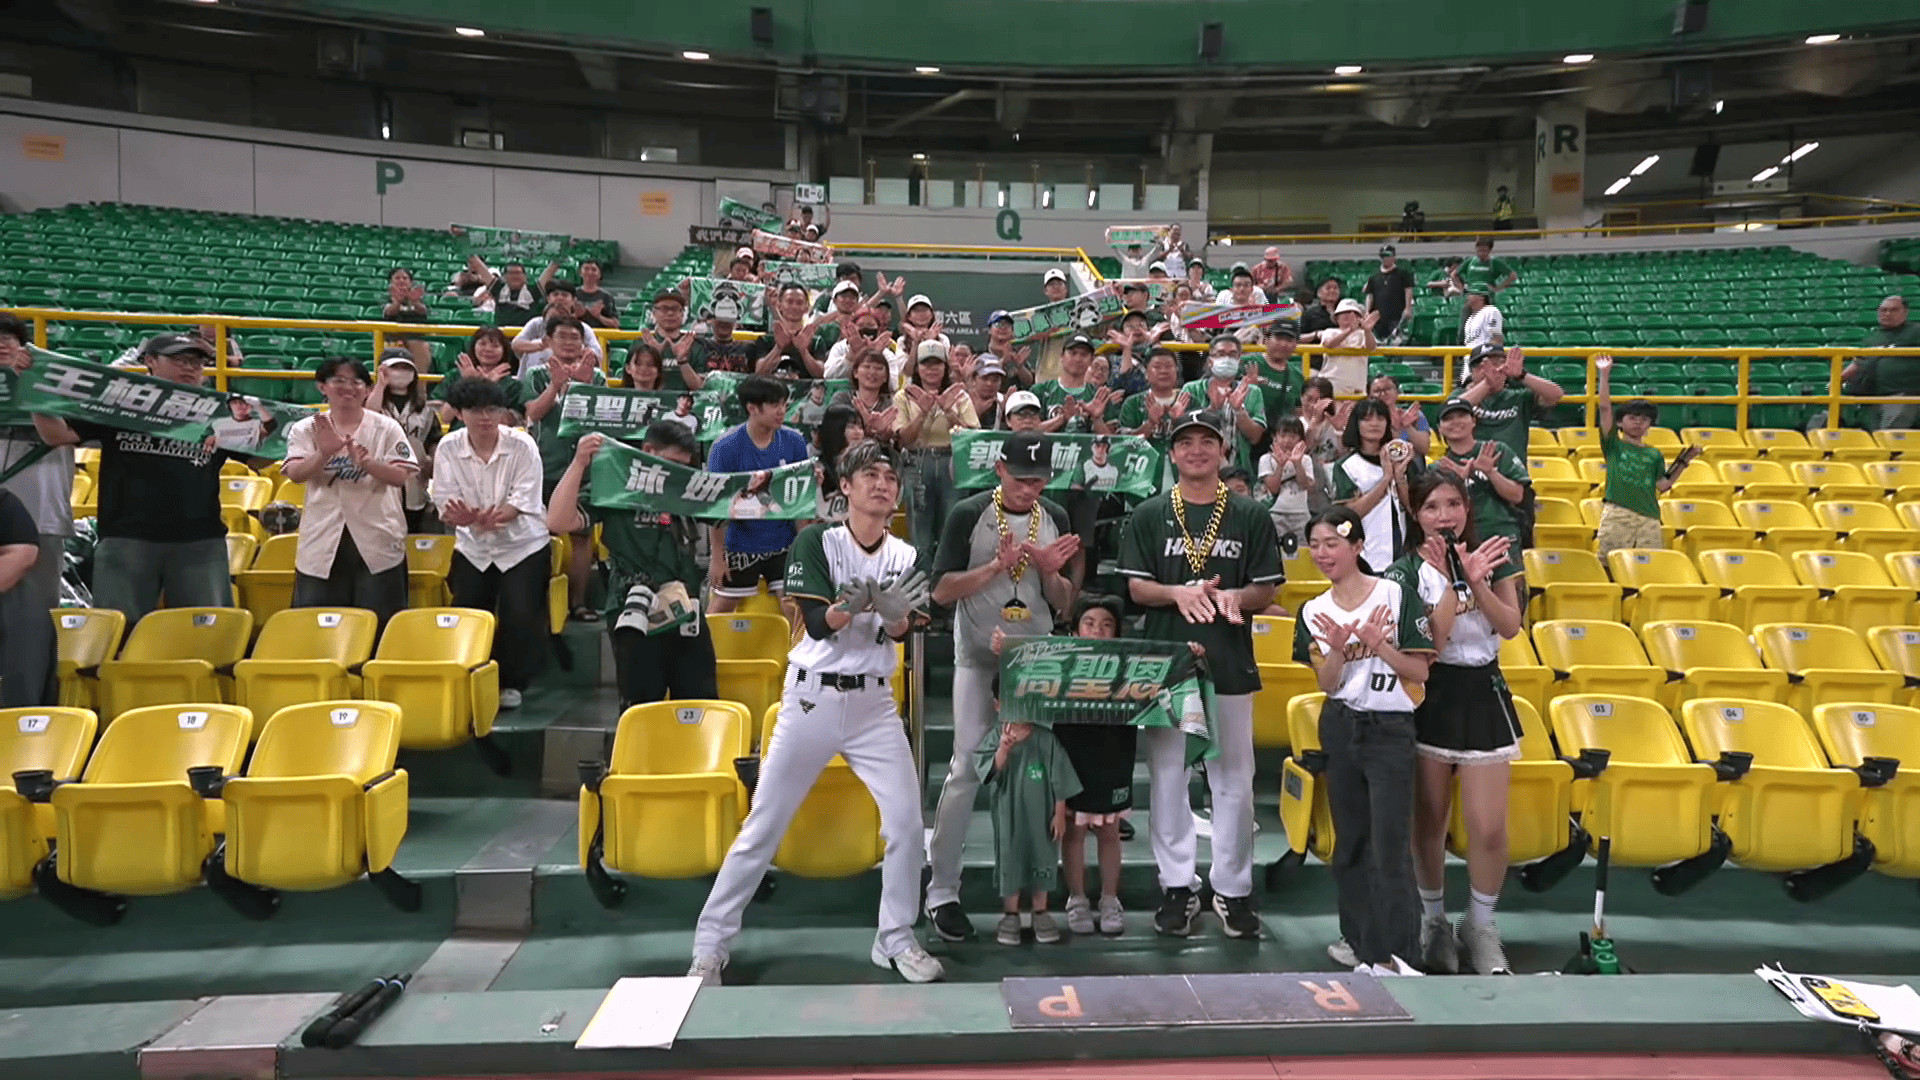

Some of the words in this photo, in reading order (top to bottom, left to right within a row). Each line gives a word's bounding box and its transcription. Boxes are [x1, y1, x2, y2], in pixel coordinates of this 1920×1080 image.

[1553, 125, 1579, 154] R
[376, 161, 404, 195] P
[996, 209, 1023, 242] Q
[33, 362, 221, 422] 王柏融
[967, 439, 1082, 471] 郭林
[783, 476, 811, 504] 07
[1013, 652, 1174, 701] 高聖恩
[1371, 673, 1398, 692] 07
[186, 716, 197, 725] 18
[338, 712, 348, 721] 19
[683, 711, 694, 720] 23
[1594, 704, 1605, 713] 03
[1726, 709, 1737, 718] 04
[1857, 713, 1869, 722] 05
[27, 719, 38, 728] 17
[1038, 984, 1084, 1018] P
[1299, 979, 1361, 1013] R
